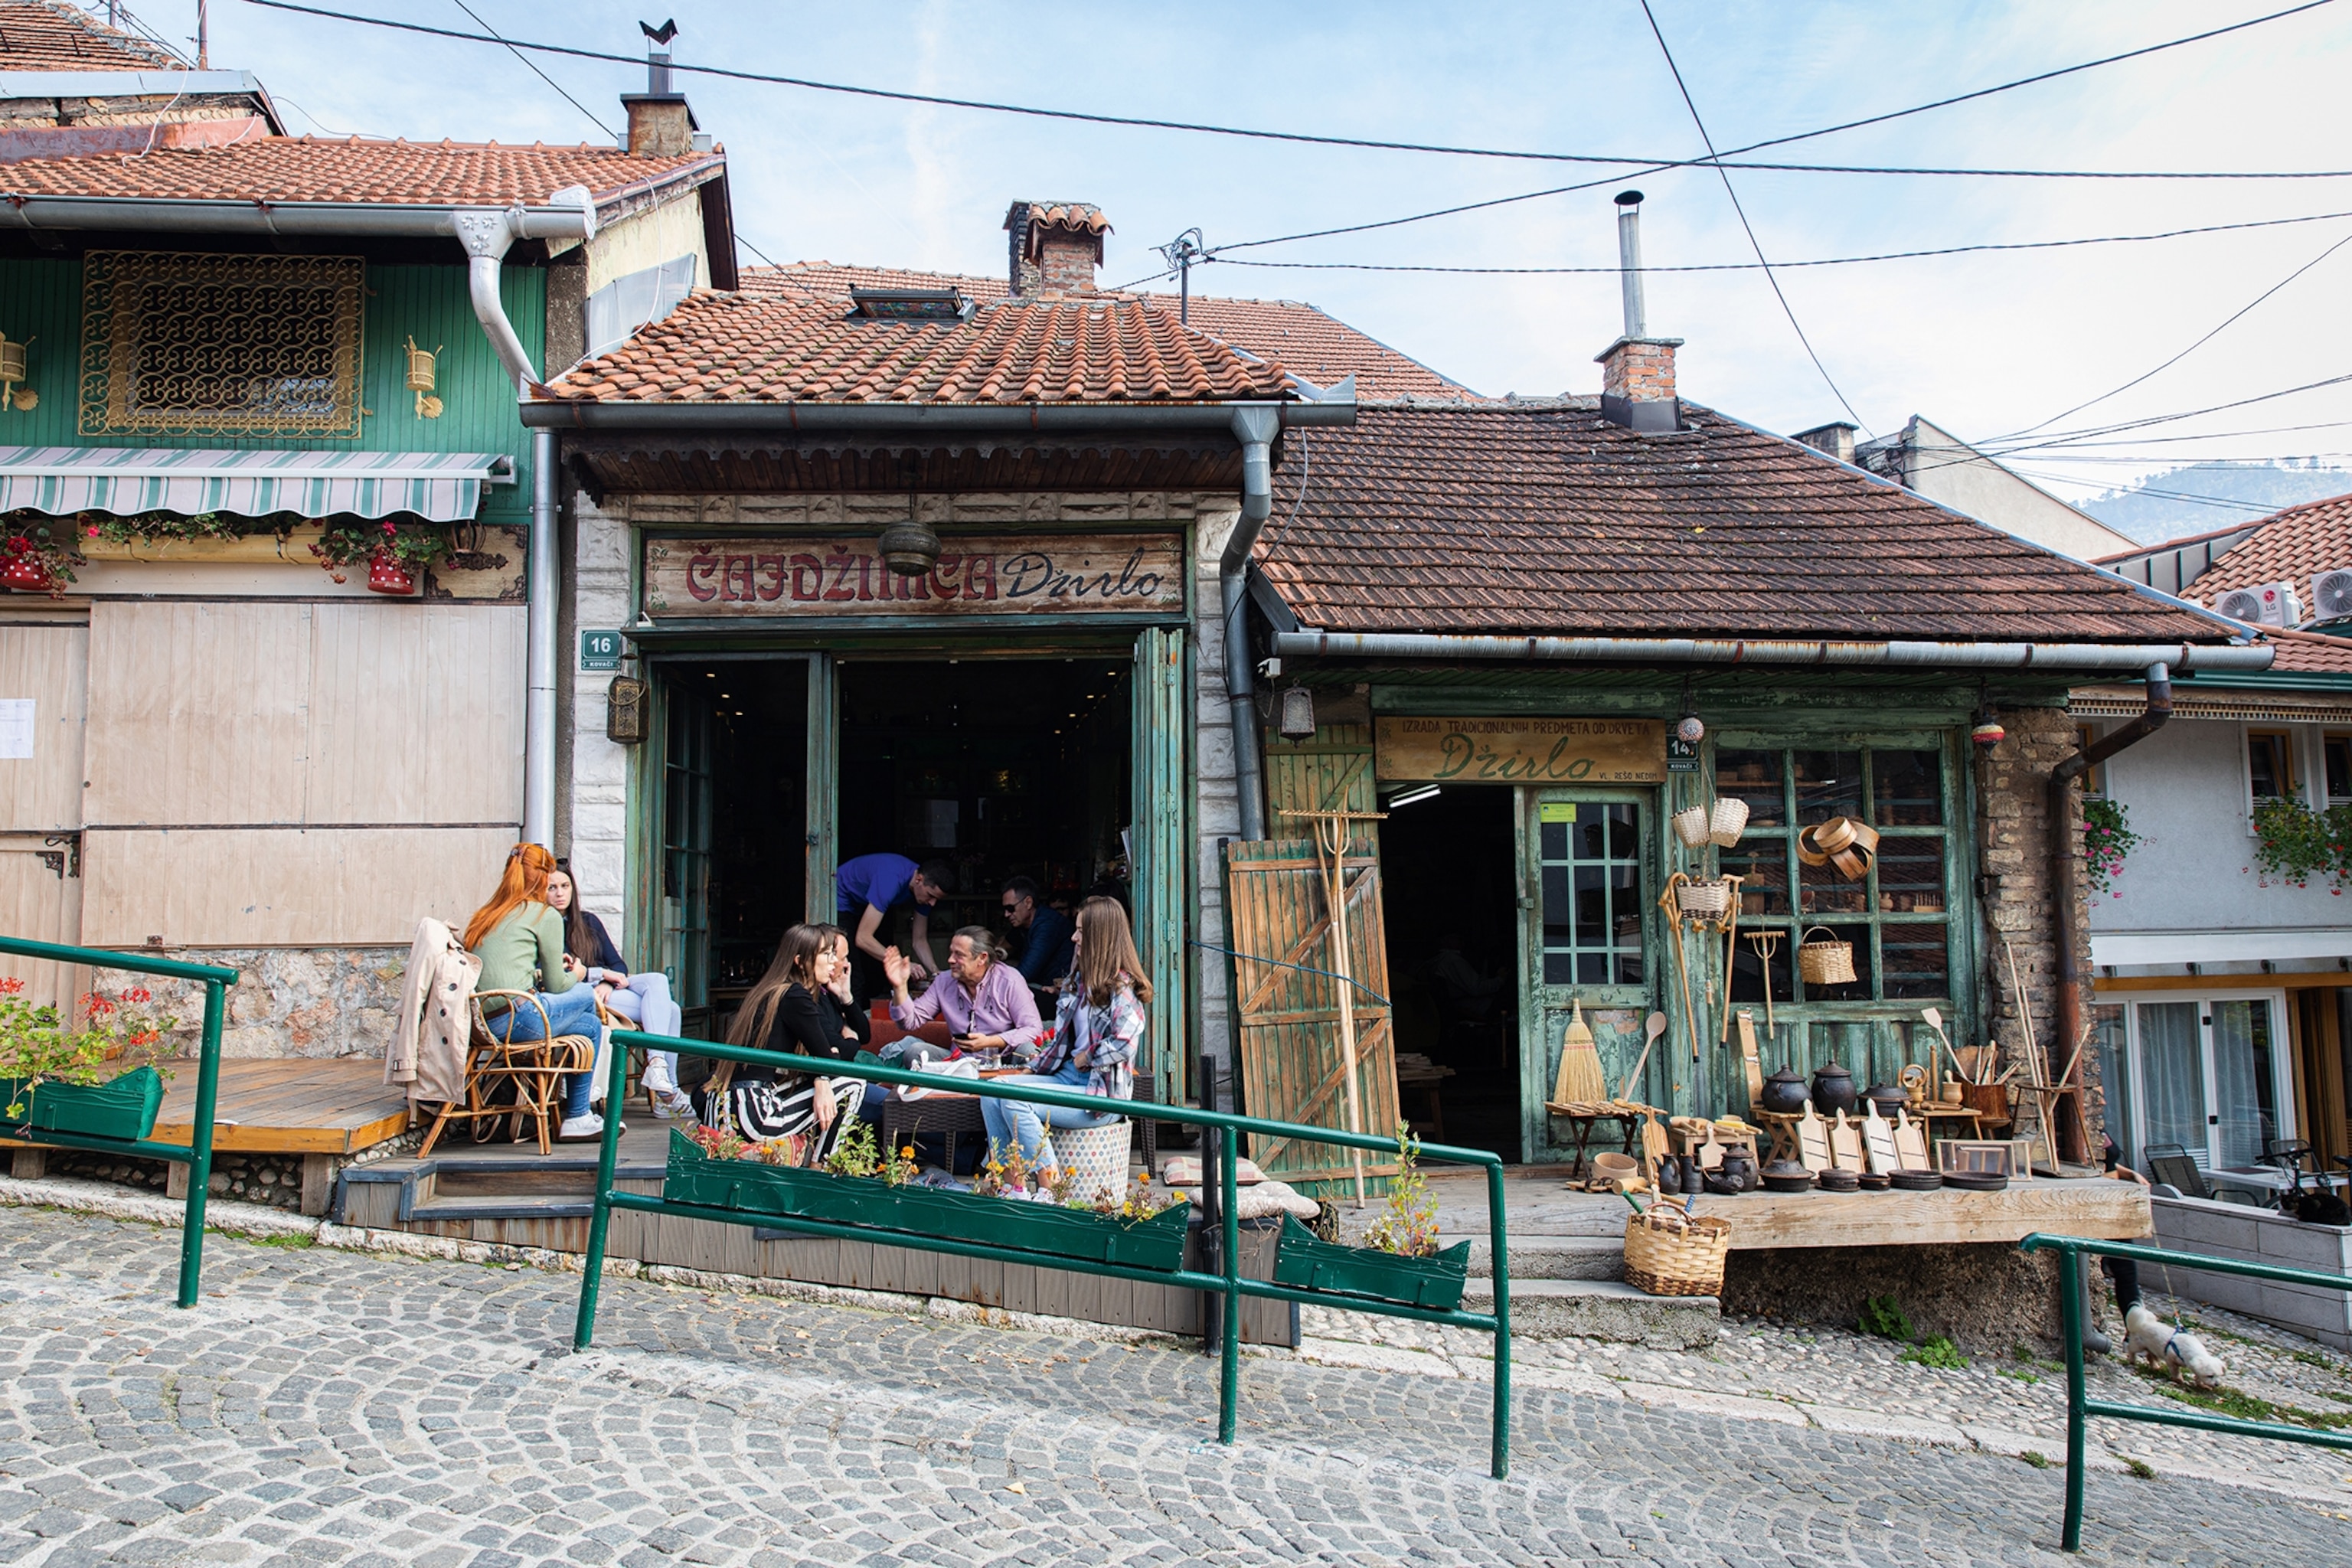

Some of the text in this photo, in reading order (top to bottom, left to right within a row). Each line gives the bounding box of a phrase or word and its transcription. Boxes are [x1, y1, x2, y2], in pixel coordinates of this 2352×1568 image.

[1002, 547, 1165, 597] Džirlo
[2265, 603, 2277, 611] LG
[591, 637, 611, 653] 16
[1403, 720, 1650, 734] IZRADA TRADICIONALNIH PREDMETA OD DRVETA
[1671, 740, 1690, 755] 14
[1433, 733, 1596, 779] Džirlo
